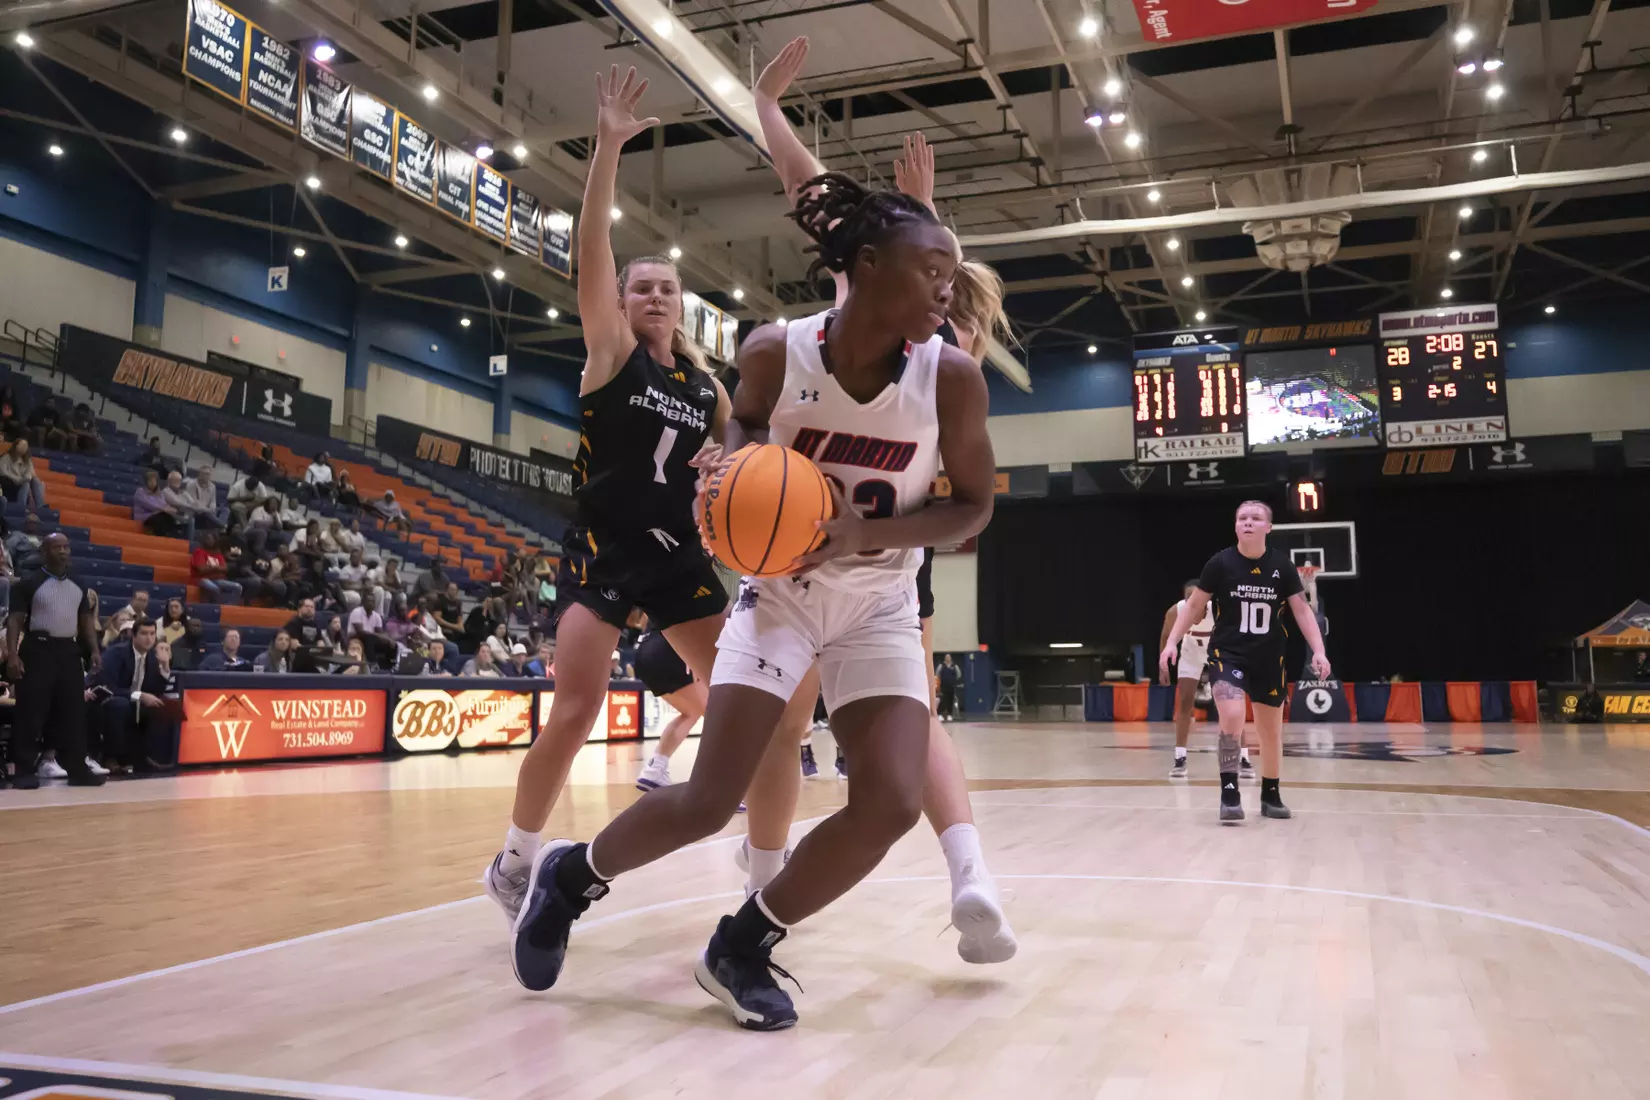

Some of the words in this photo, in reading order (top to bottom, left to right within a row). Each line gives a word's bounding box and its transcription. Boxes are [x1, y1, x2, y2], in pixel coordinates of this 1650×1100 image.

[195, 17, 240, 49] BASKETBALL
[1148, 10, 1172, 39] Agent
[202, 35, 234, 63] VSAC
[262, 36, 290, 60] 1982
[189, 45, 241, 82] CHAMPIONS
[258, 69, 290, 94] NCAA
[249, 79, 297, 111] TOURNAMENT
[307, 111, 346, 140] HAMPIONS
[363, 128, 384, 147] GSC
[352, 137, 391, 164] CHAMPIONS
[271, 275, 283, 290] K
[1172, 333, 1199, 346] ATA
[1303, 319, 1372, 340] SKYHAWKS
[1426, 333, 1463, 353] 2:08
[1474, 340, 1498, 359] 27
[1387, 347, 1410, 366] 28
[1452, 356, 1462, 370] 2
[493, 363, 504, 373] L
[112, 349, 233, 409] SKYHAWKS
[1486, 381, 1497, 394] 4
[646, 385, 706, 421] NORTH
[1392, 387, 1402, 401] 3
[653, 425, 679, 485] 1
[818, 431, 918, 473] MARTIN
[1237, 584, 1275, 594] NORTH
[1239, 600, 1272, 635] 10
[271, 699, 367, 719] WINSTEAD
[466, 697, 530, 716] Furniture
[1603, 696, 1633, 714] FAN
[271, 719, 286, 730] Real
[286, 718, 308, 729] Estate
[313, 718, 330, 729] Land
[396, 700, 455, 739] BB's
[210, 720, 253, 760] W
[283, 731, 354, 748] 731.504.8969
